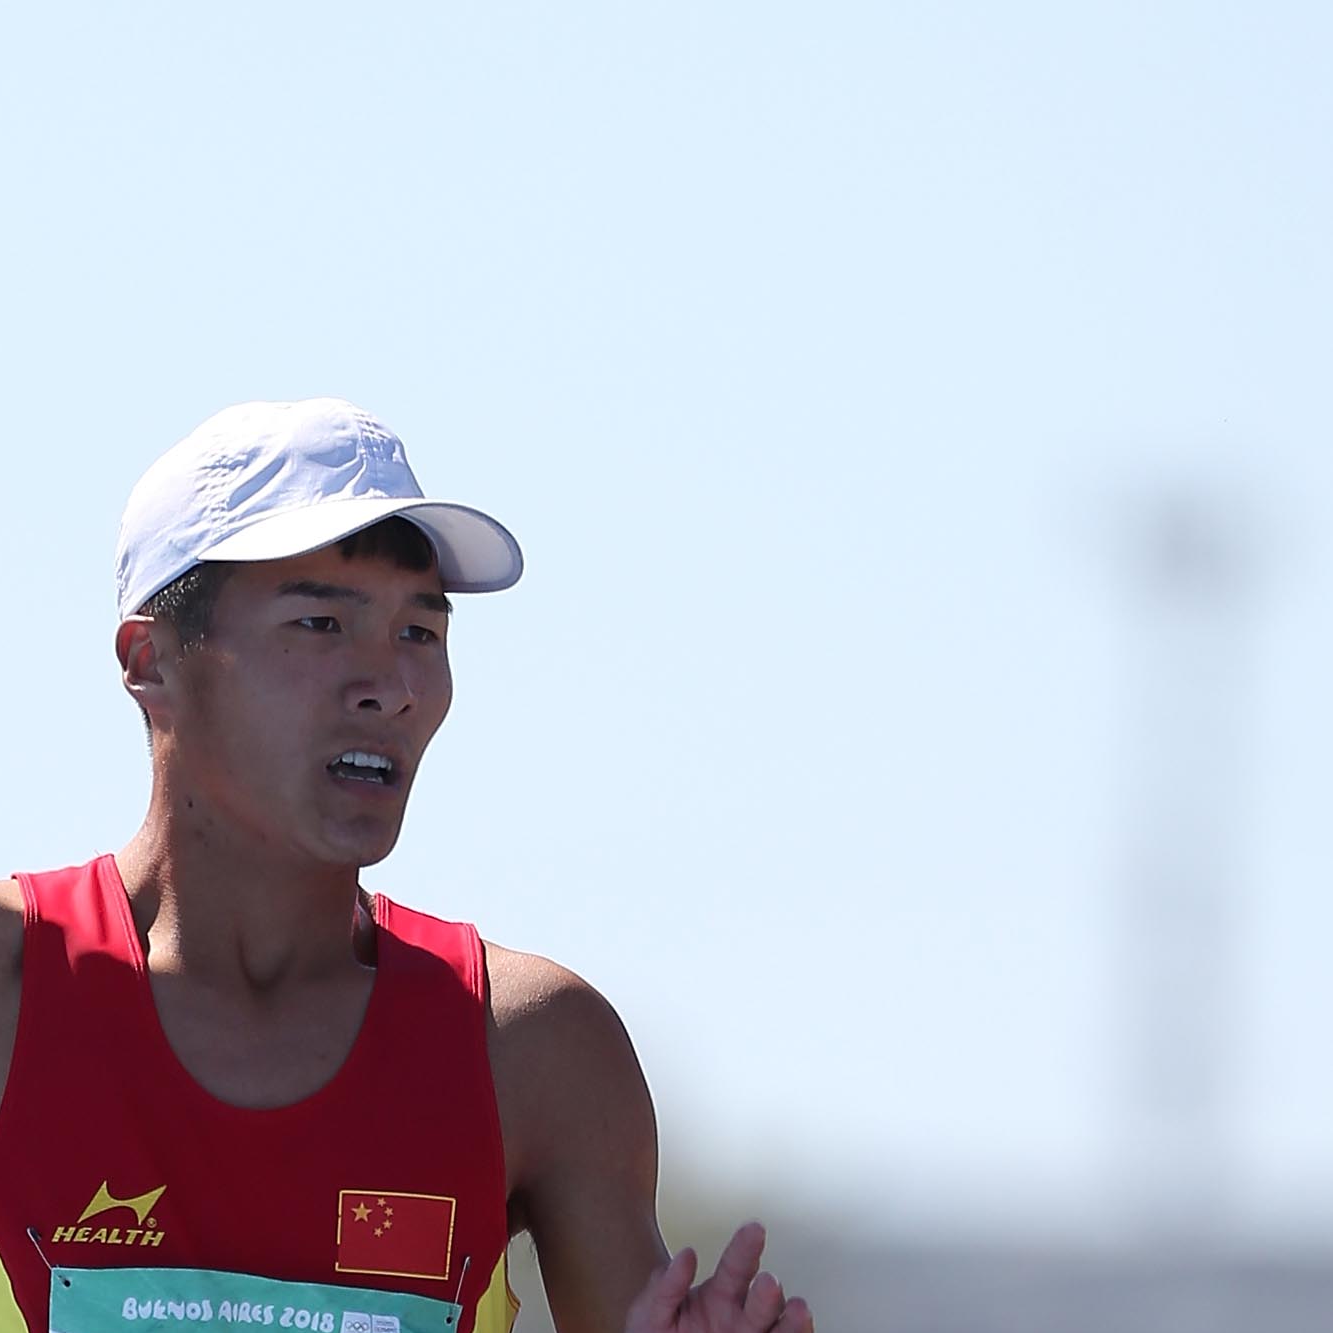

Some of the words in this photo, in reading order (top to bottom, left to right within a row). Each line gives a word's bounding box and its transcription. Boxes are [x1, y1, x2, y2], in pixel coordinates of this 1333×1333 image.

[51, 1226, 165, 1247] HEALTH
[122, 1297, 214, 1321] BUENOS
[218, 1300, 274, 1325] AIRES
[279, 1307, 335, 1333] 2018
